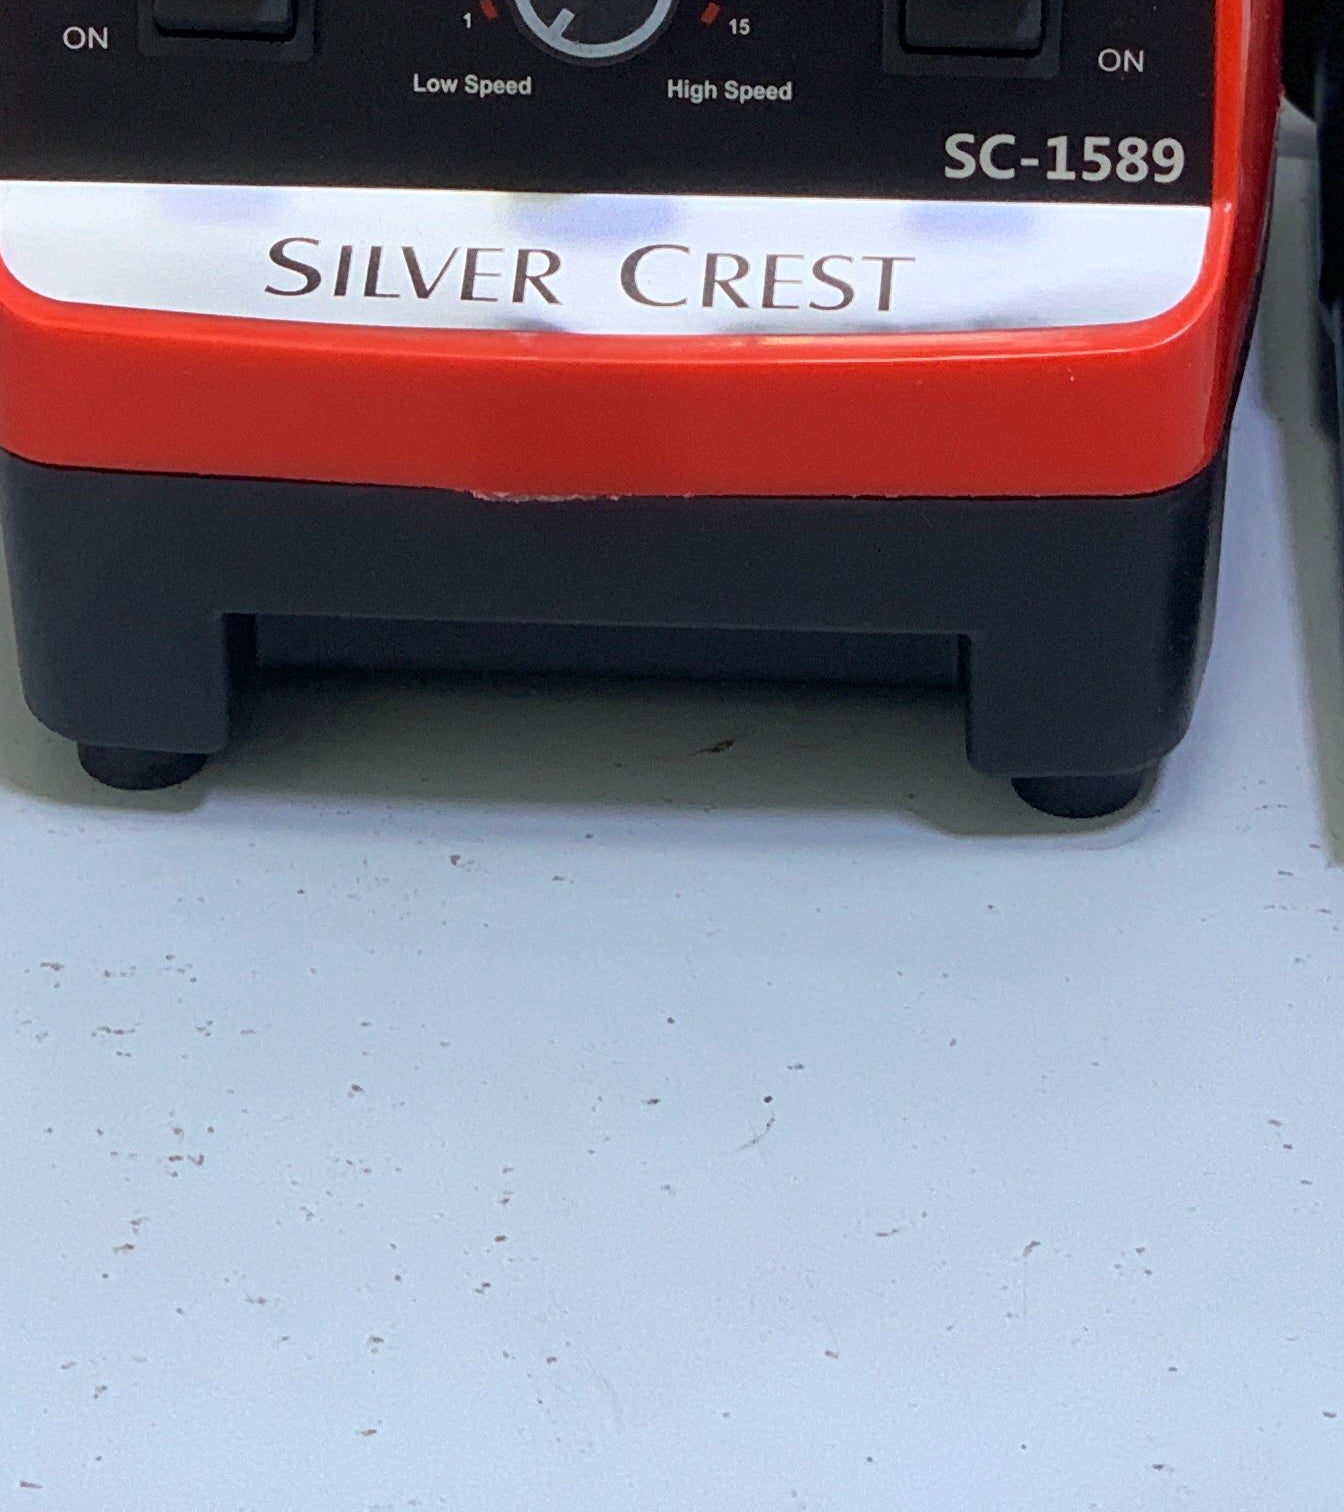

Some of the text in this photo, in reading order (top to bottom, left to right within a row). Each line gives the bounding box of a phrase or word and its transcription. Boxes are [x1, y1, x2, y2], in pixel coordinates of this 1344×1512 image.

[464, 13, 472, 30] 1
[730, 19, 751, 36] 15
[63, 27, 109, 51] ON
[1099, 49, 1145, 74] ON
[414, 74, 533, 99] Low Speed
[668, 80, 793, 105] High Speed
[945, 134, 1186, 185] SC-1589
[265, 238, 914, 313] SILVER CREST
